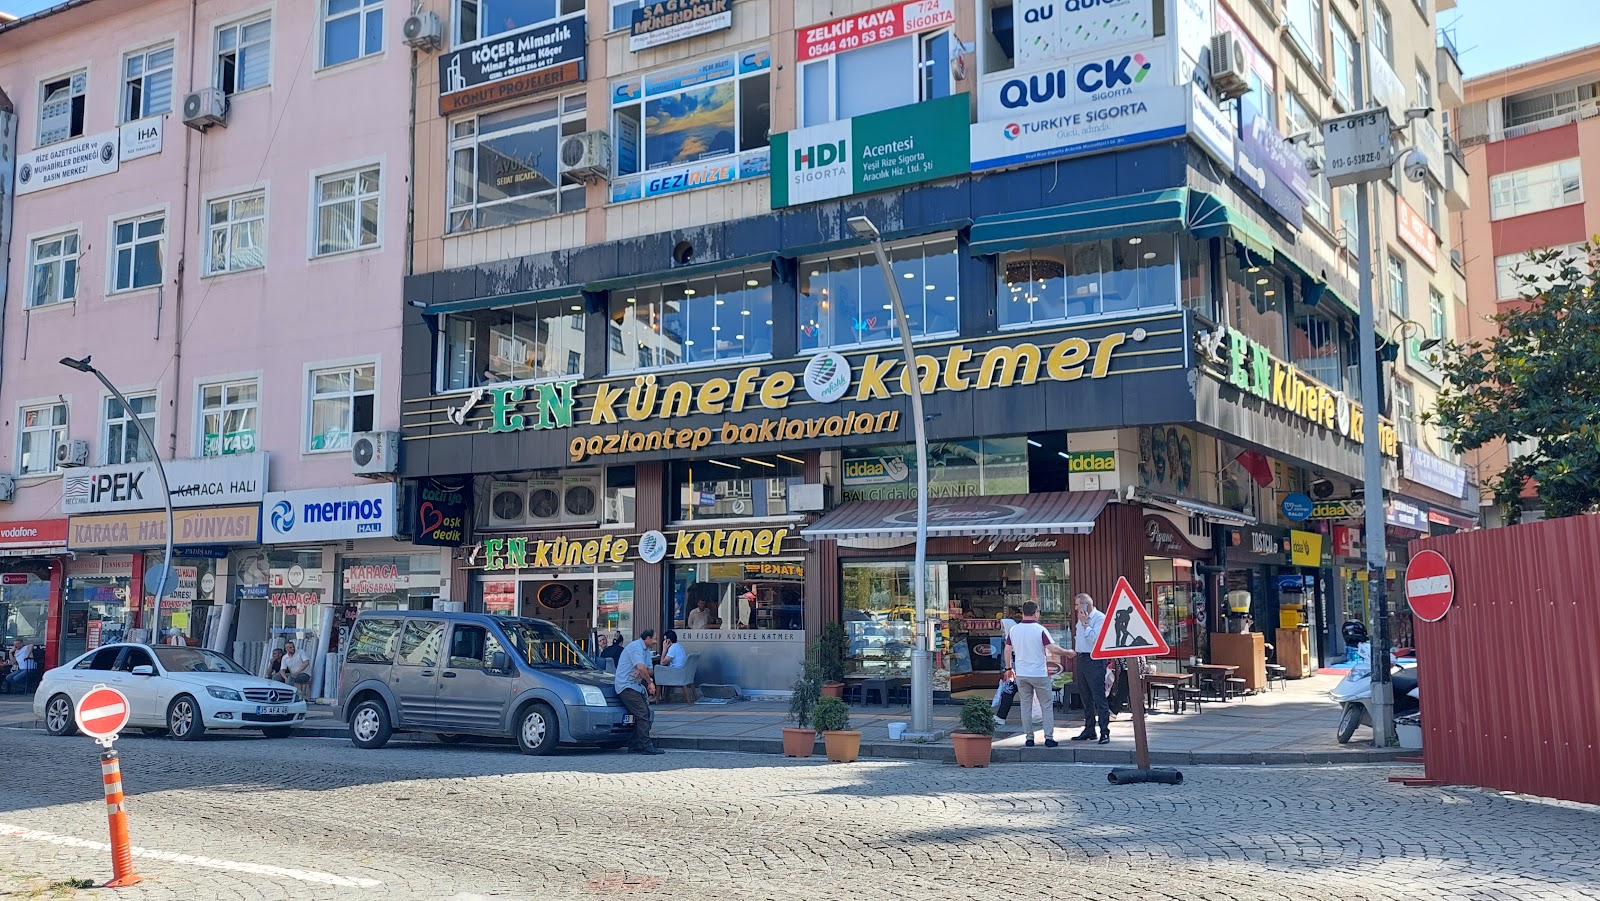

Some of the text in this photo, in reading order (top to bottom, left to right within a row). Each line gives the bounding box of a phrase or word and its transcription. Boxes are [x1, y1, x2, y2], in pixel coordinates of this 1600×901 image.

[918, 0, 939, 13] 7/24
[806, 9, 896, 44] ZELKİF KAYA
[906, 10, 953, 31] SİGORTA
[472, 25, 571, 65] KÖÇER Mimarlık
[808, 25, 894, 57] 0544 410 53 53
[481, 46, 563, 74] Mimar Serkan Köçer
[454, 67, 564, 108] KONUT PROJELERİ
[138, 127, 158, 141] İHA
[35, 152, 49, 163] RİZE
[50, 143, 90, 160] GAZETECİLER
[795, 139, 846, 172] HDI
[862, 136, 914, 159] Acentesi
[34, 151, 99, 174] MUHABİRLER DERNEĞİ
[862, 151, 925, 172] Yeşil Rize Sigorta
[862, 160, 933, 183] Aracılık Hiz. Ltd. Şti
[43, 165, 88, 183] BASIN MERKEZİ
[795, 166, 847, 185] SİGORTA
[488, 332, 1127, 434] EN künefe katmer
[1228, 326, 1336, 430] EN künefe
[569, 410, 899, 463] gaziantep baklavaları
[846, 460, 884, 477] iddaa
[1069, 455, 1115, 471] iddaa
[178, 480, 256, 497] KARACA HALI
[908, 484, 978, 499] ONANIR
[303, 498, 382, 523] merinos
[1310, 504, 1345, 517] ddaa
[0, 527, 38, 538] vodafone
[74, 513, 251, 544] KARACA HAL DÜNYASI
[358, 524, 380, 533] HALI
[433, 530, 461, 541] dedik
[484, 528, 788, 571] EN künefe katmer
[350, 565, 398, 579] KARACA
[271, 592, 318, 606] KARACA
[683, 632, 692, 640] EN
